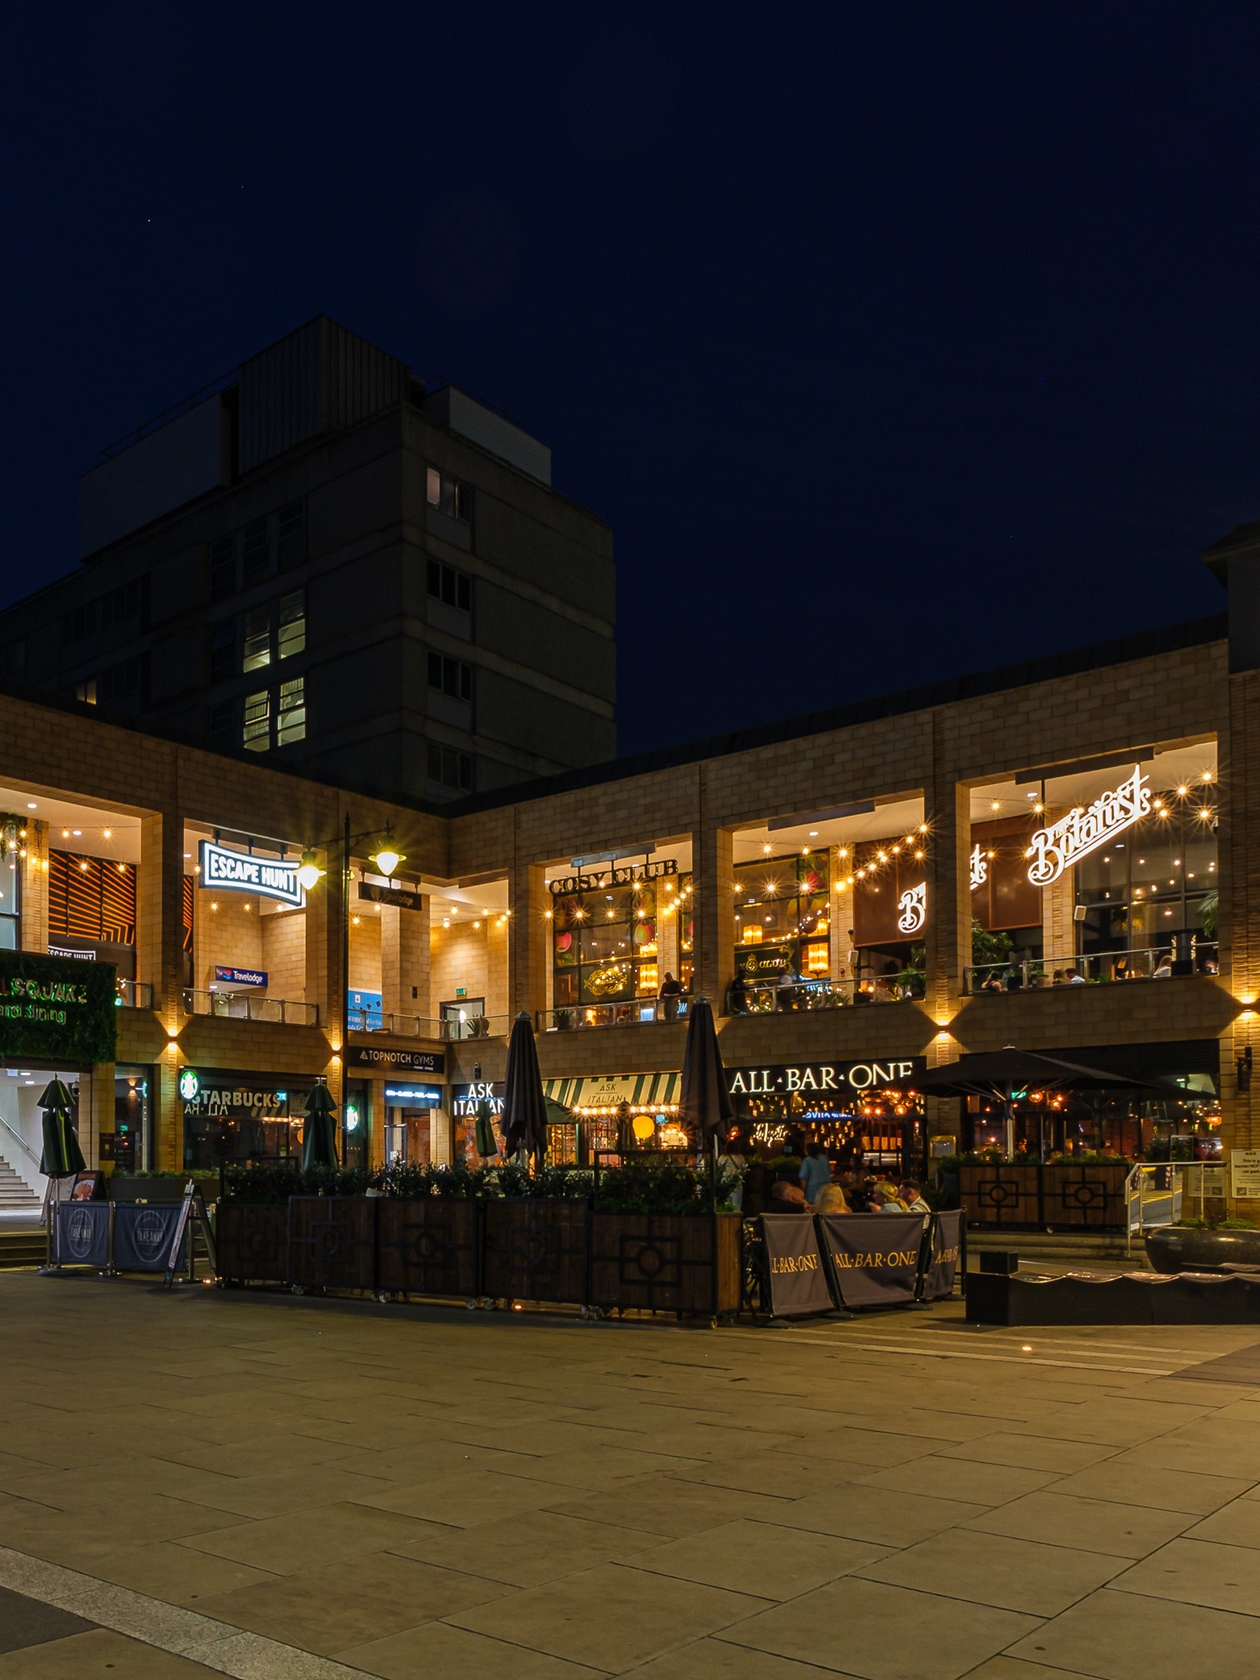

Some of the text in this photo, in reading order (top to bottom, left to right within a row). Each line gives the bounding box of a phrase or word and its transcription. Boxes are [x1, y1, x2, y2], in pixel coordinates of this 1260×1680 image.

[1024, 763, 1152, 887] Botanist
[210, 852, 295, 893] ESCAPE HUNT
[548, 858, 679, 896] COSY CLUB
[232, 970, 263, 984] Travelodge
[24, 1004, 67, 1026] dining
[368, 1049, 435, 1066] TOPNOTCH GYMS
[467, 1082, 494, 1099] ASK
[599, 1083, 617, 1092] ASK
[587, 1095, 623, 1104] ITALIAN
